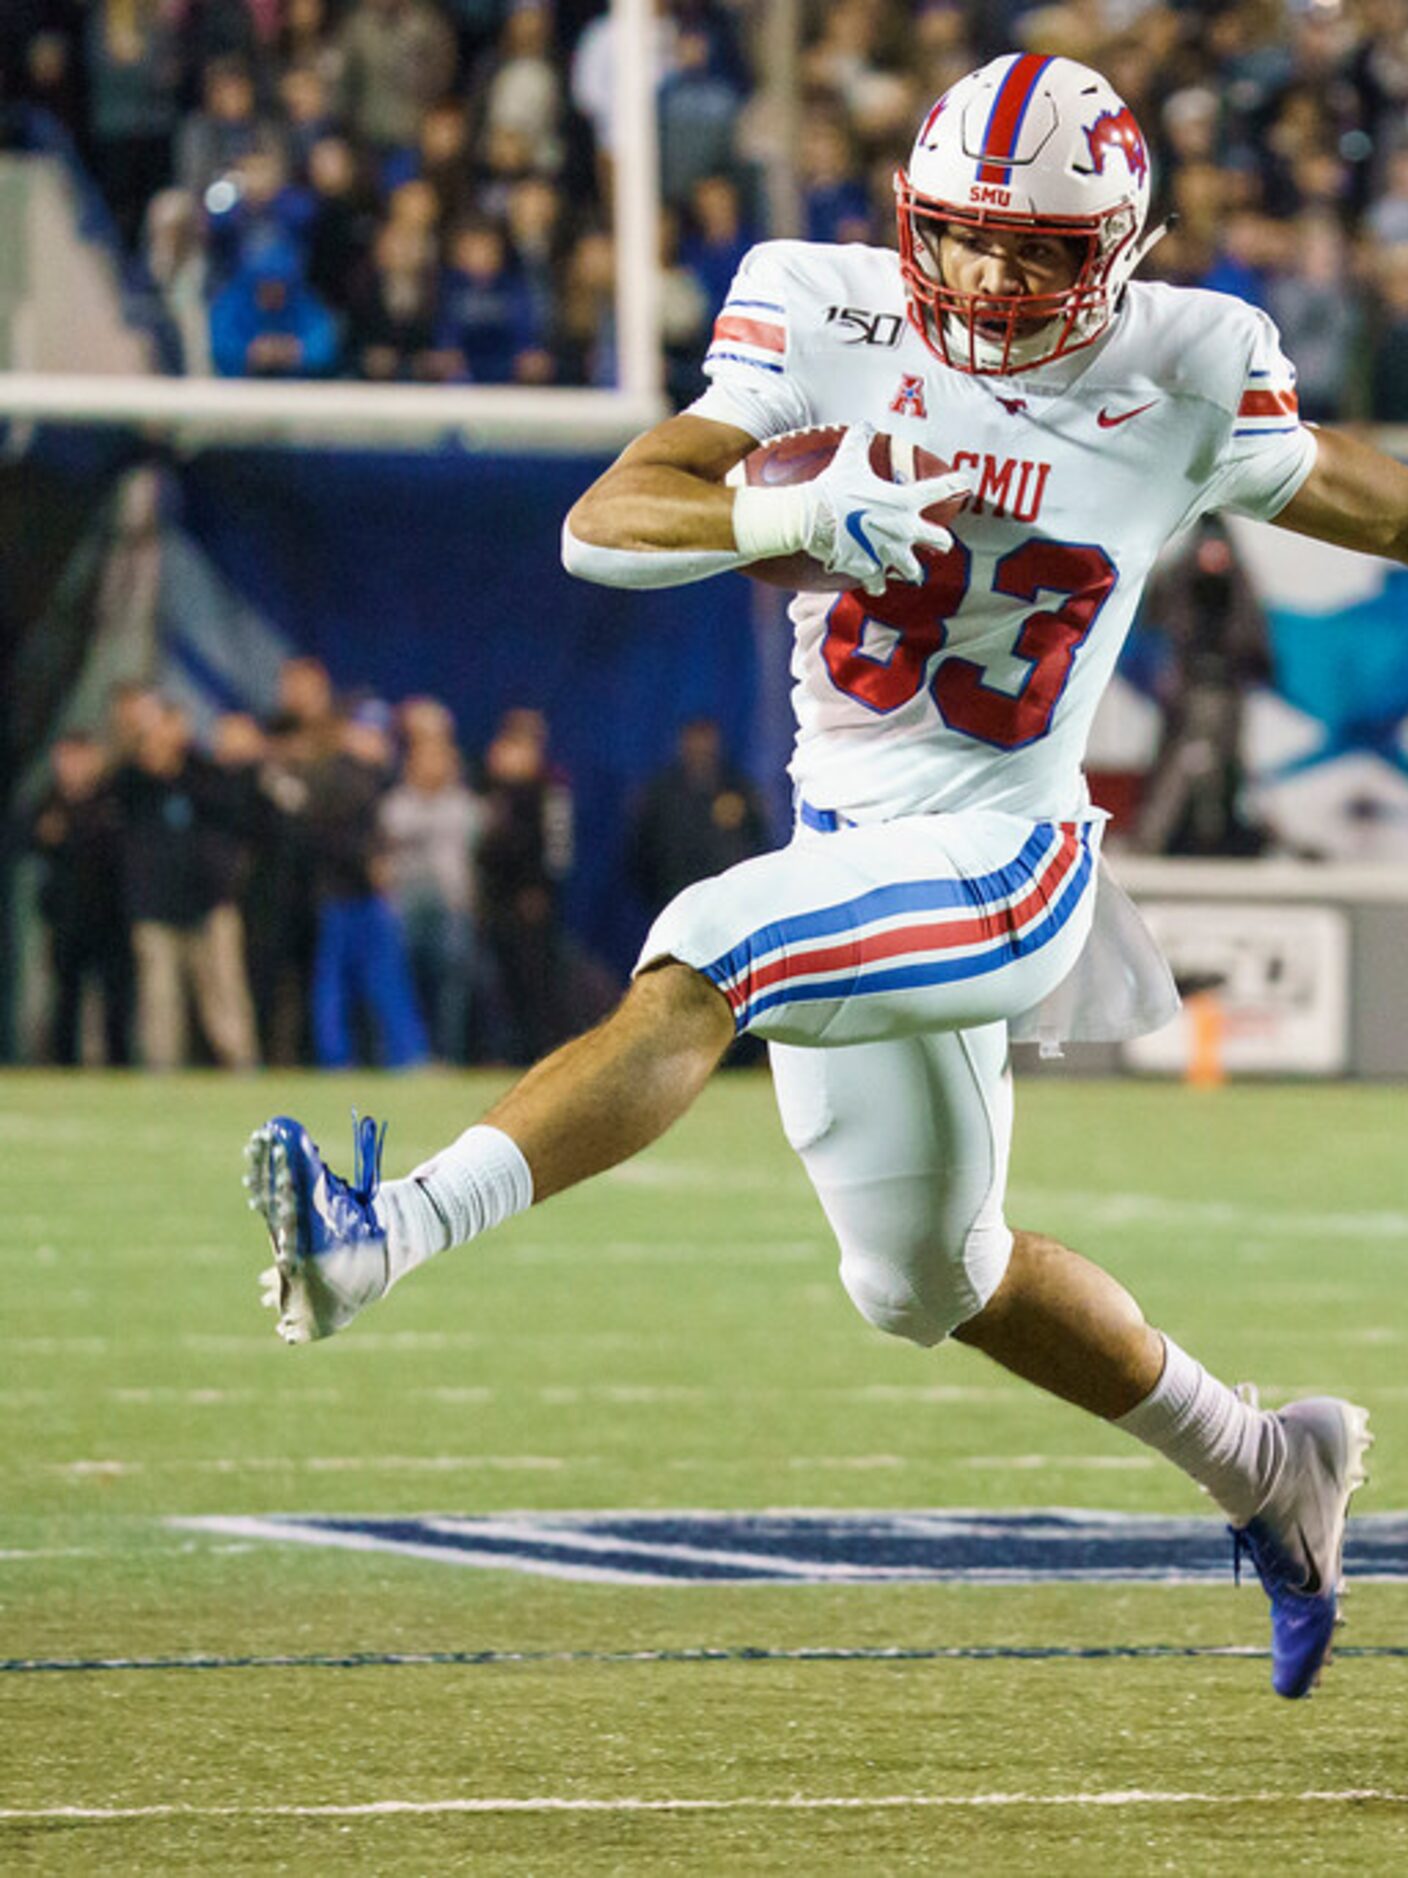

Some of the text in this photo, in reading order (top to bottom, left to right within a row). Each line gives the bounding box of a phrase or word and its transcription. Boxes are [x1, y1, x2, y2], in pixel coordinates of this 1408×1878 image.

[969, 186, 1012, 207] SMU
[825, 305, 905, 348] 150
[820, 528, 1119, 753] 83
